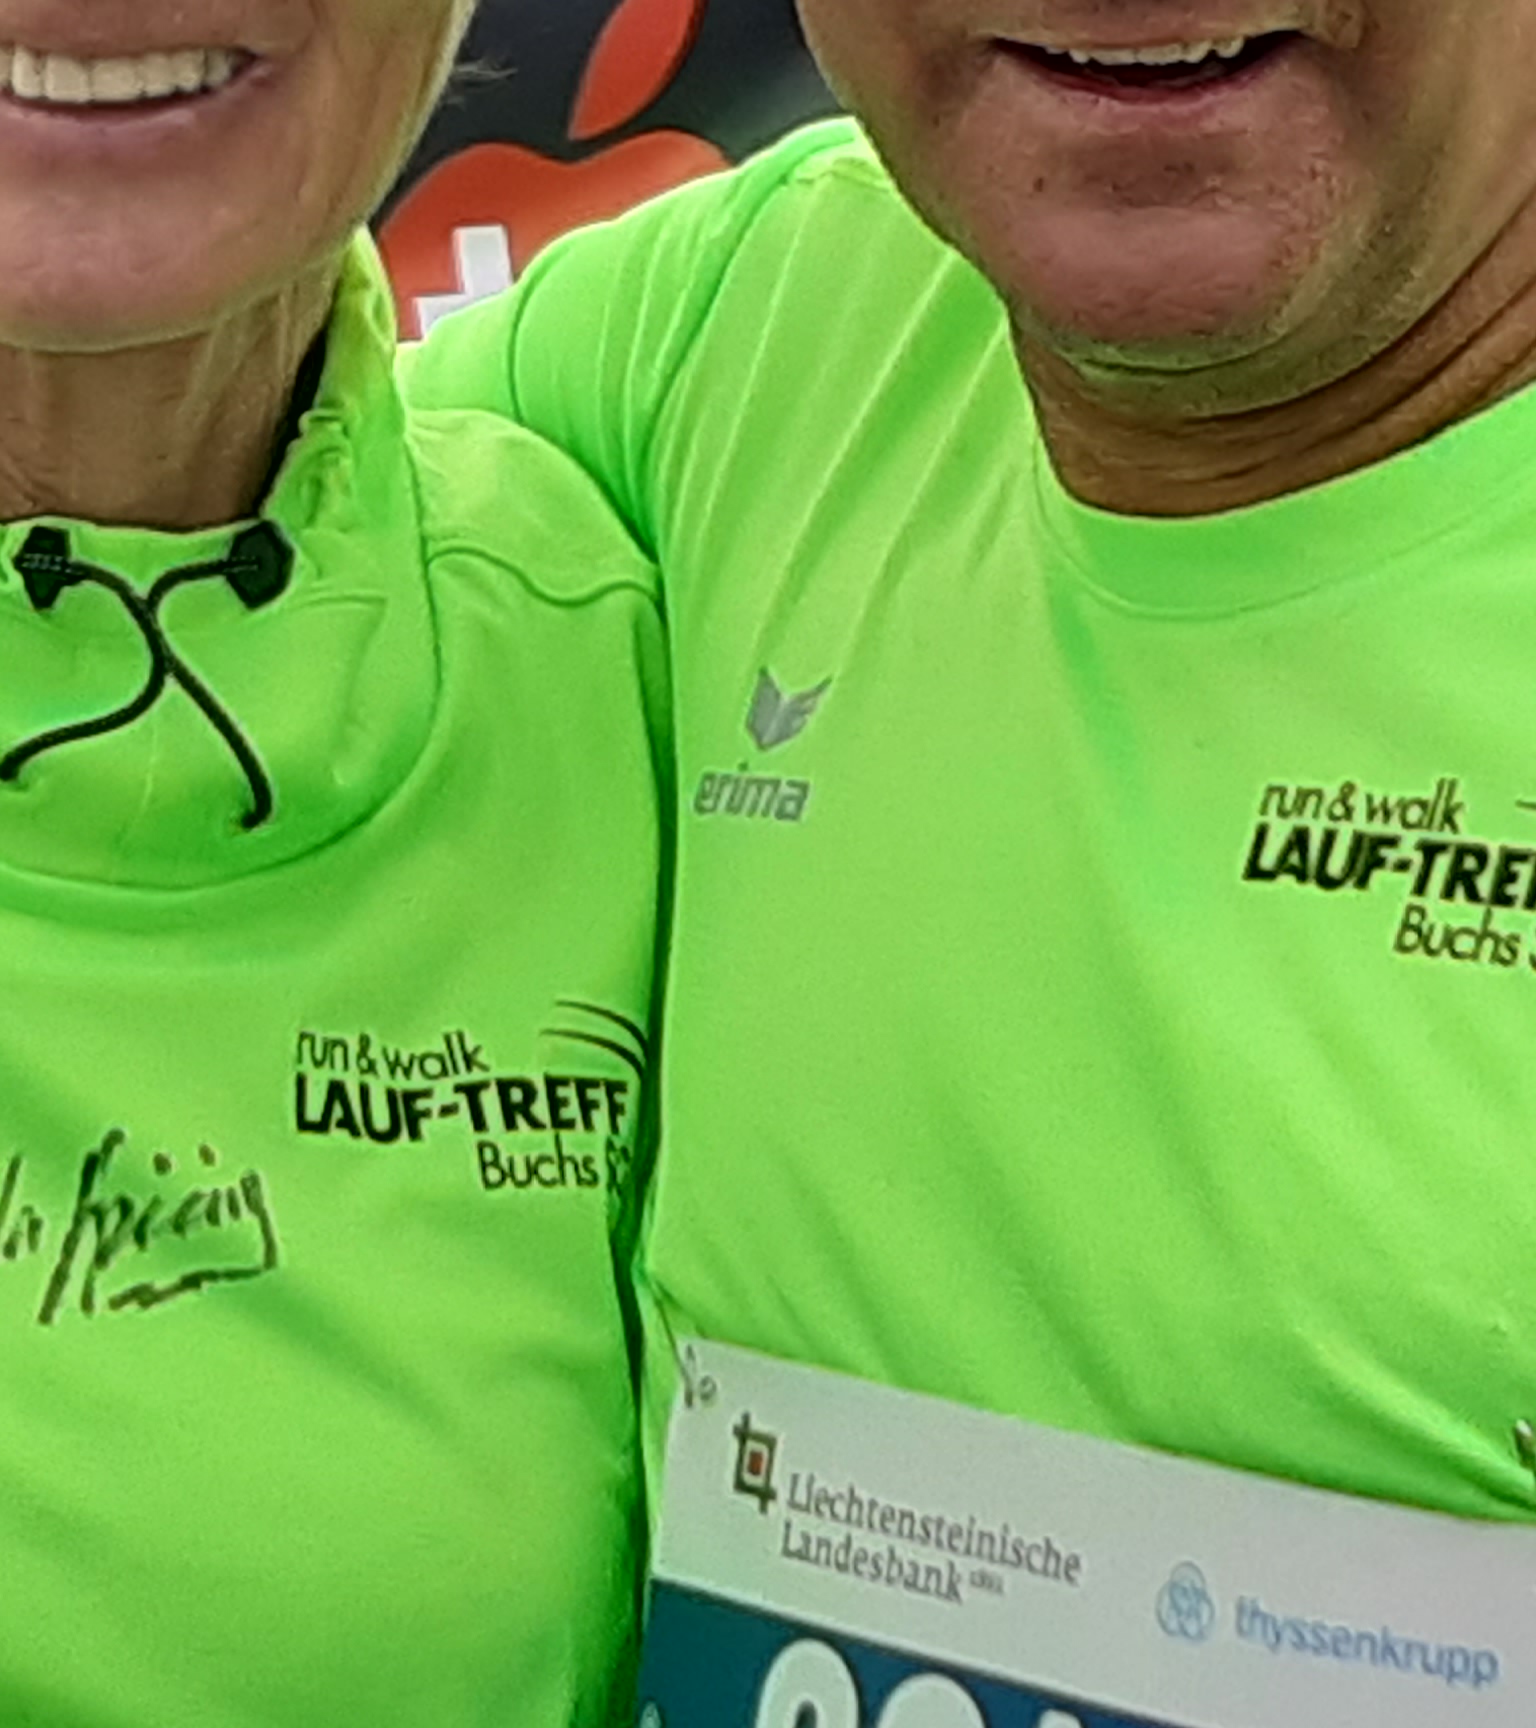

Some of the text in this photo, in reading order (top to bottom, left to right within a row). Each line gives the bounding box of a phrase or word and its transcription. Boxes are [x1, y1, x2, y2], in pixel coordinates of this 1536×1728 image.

[693, 759, 811, 823] erima
[1260, 778, 1462, 835] run & walk
[1393, 904, 1521, 969] Buchs
[297, 1029, 491, 1081] run & walk
[295, 1071, 629, 1145] LAUF-TREFF
[476, 1131, 601, 1191] Buchs
[785, 1471, 1083, 1588] Liechtensteinische
[781, 1519, 964, 1606] Landesbank
[1234, 1594, 1501, 1691] thyssenkrupp
